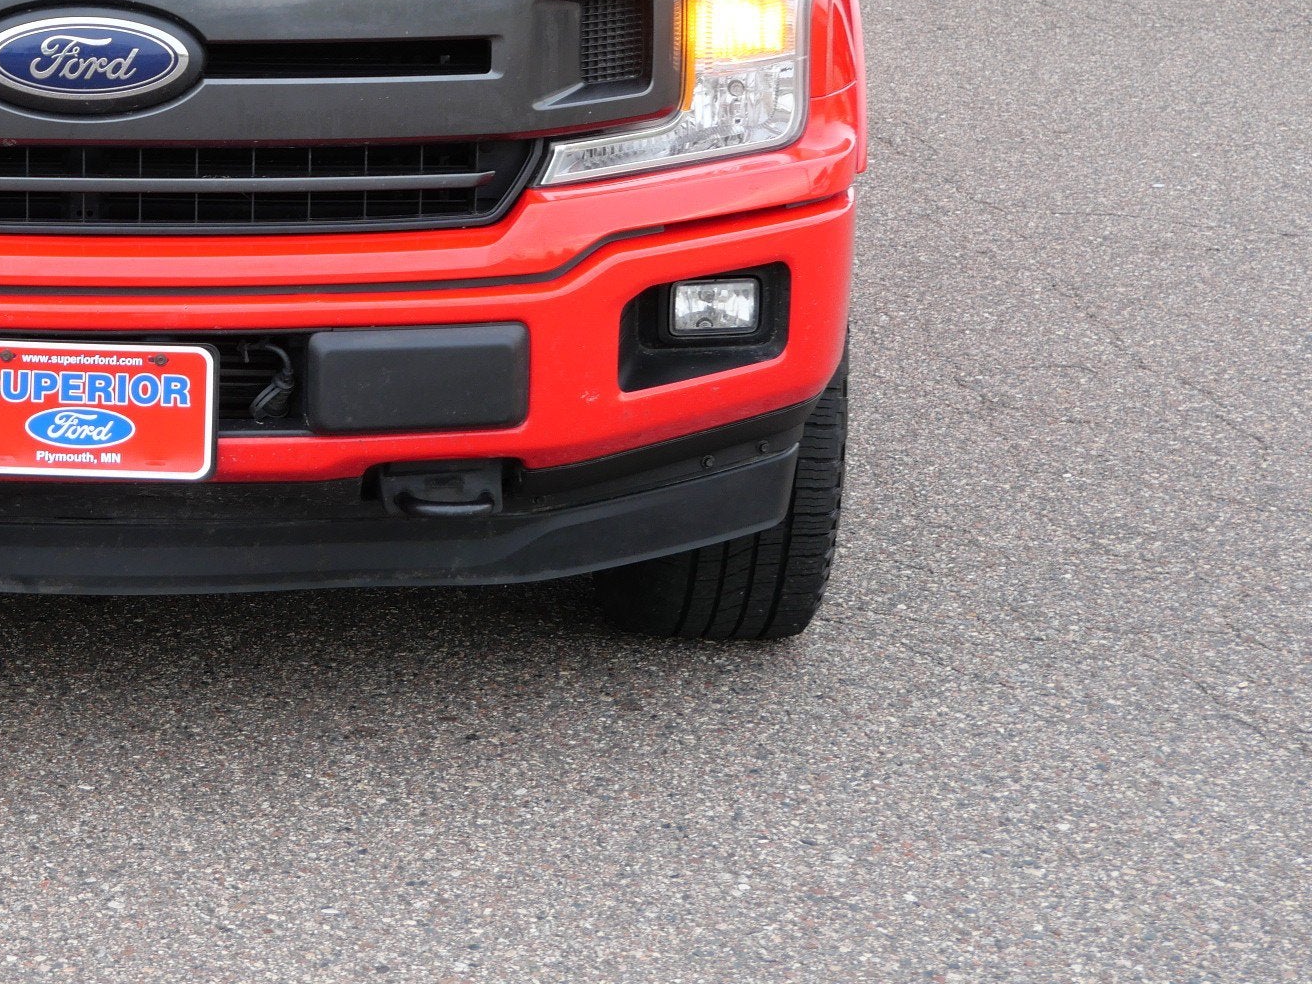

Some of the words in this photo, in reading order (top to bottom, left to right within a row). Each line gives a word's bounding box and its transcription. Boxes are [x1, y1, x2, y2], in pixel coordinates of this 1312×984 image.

[29, 34, 139, 81] Ford
[21, 352, 143, 366] www.superiorford.com
[47, 411, 115, 442] Ford
[35, 450, 98, 465] Plymouth,
[100, 451, 121, 464] MN
